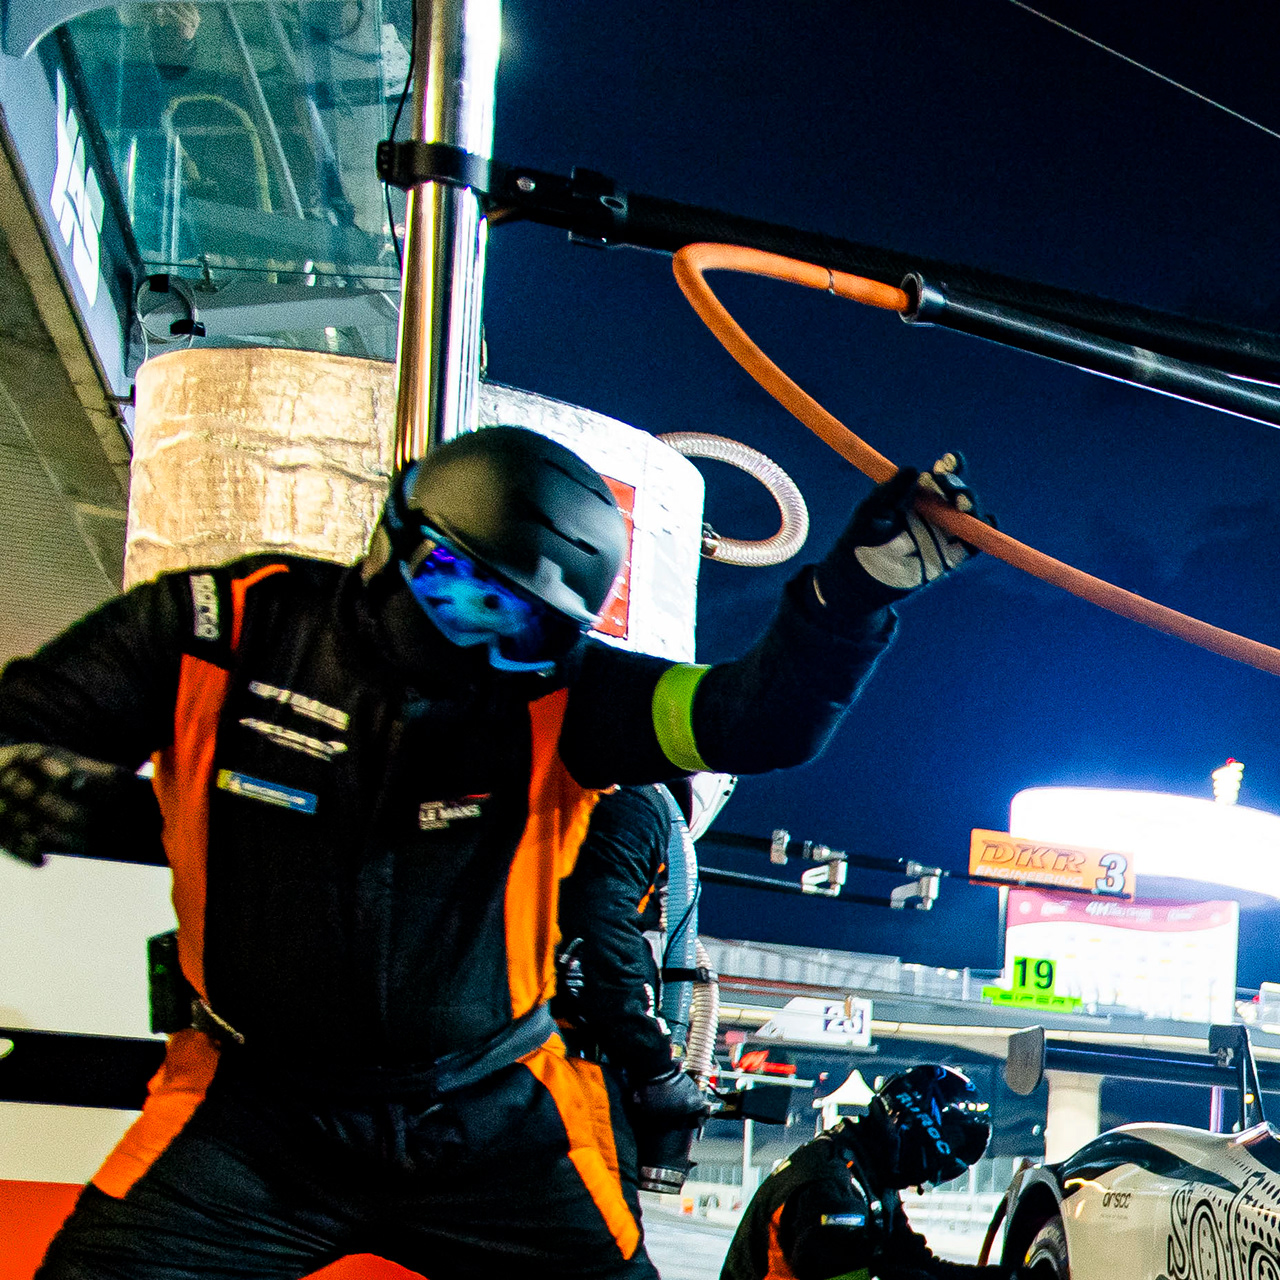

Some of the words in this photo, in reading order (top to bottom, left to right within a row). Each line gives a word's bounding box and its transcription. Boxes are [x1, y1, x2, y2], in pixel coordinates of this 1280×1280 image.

[974, 864, 1084, 888] ENGINEERING
[979, 839, 1087, 874] DKR
[1094, 852, 1128, 894] 3
[1014, 956, 1055, 990] 19
